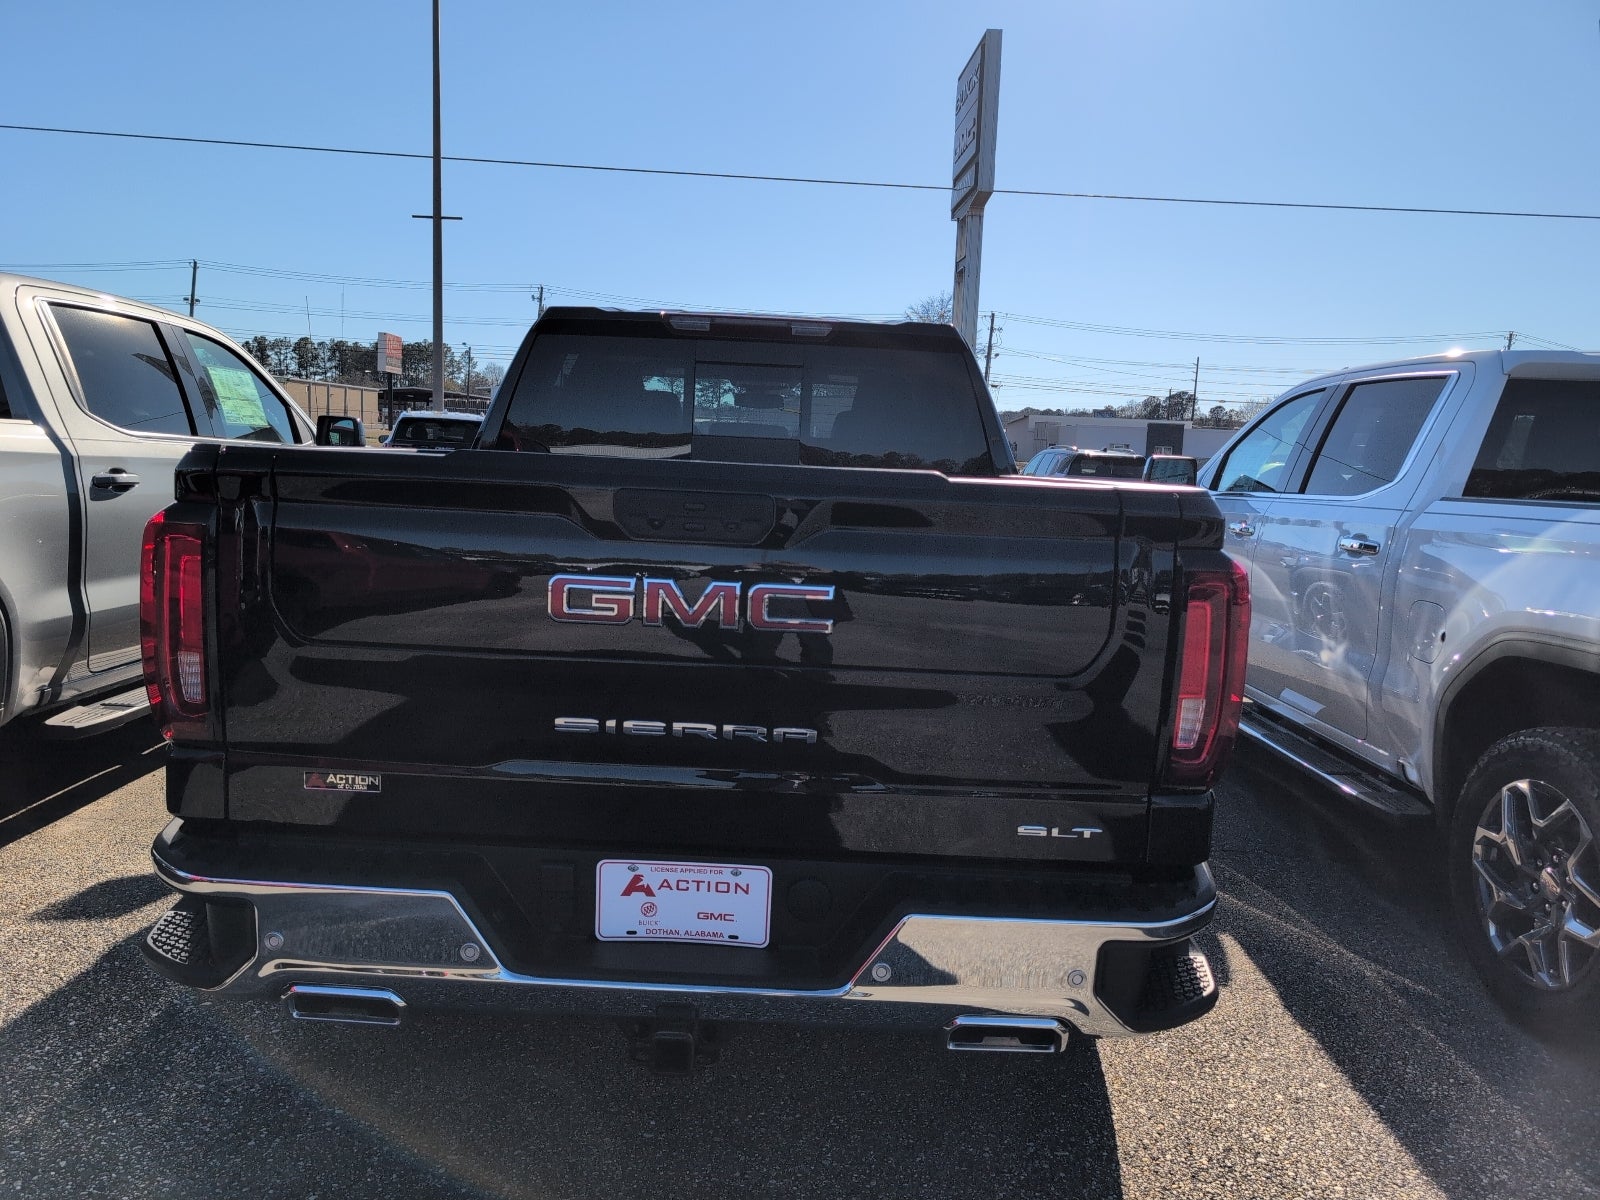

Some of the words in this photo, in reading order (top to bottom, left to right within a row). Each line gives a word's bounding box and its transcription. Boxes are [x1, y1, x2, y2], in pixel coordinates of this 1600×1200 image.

[548, 573, 835, 634] GMC
[554, 717, 818, 744] SIERRA
[326, 773, 379, 786] ACTION
[1017, 825, 1103, 838] SLT
[680, 867, 708, 875] APPLIED
[657, 878, 750, 895] ACTION
[697, 911, 735, 922] GMC
[645, 928, 682, 936] DOTHAN,
[684, 930, 725, 939] ALABAMA
